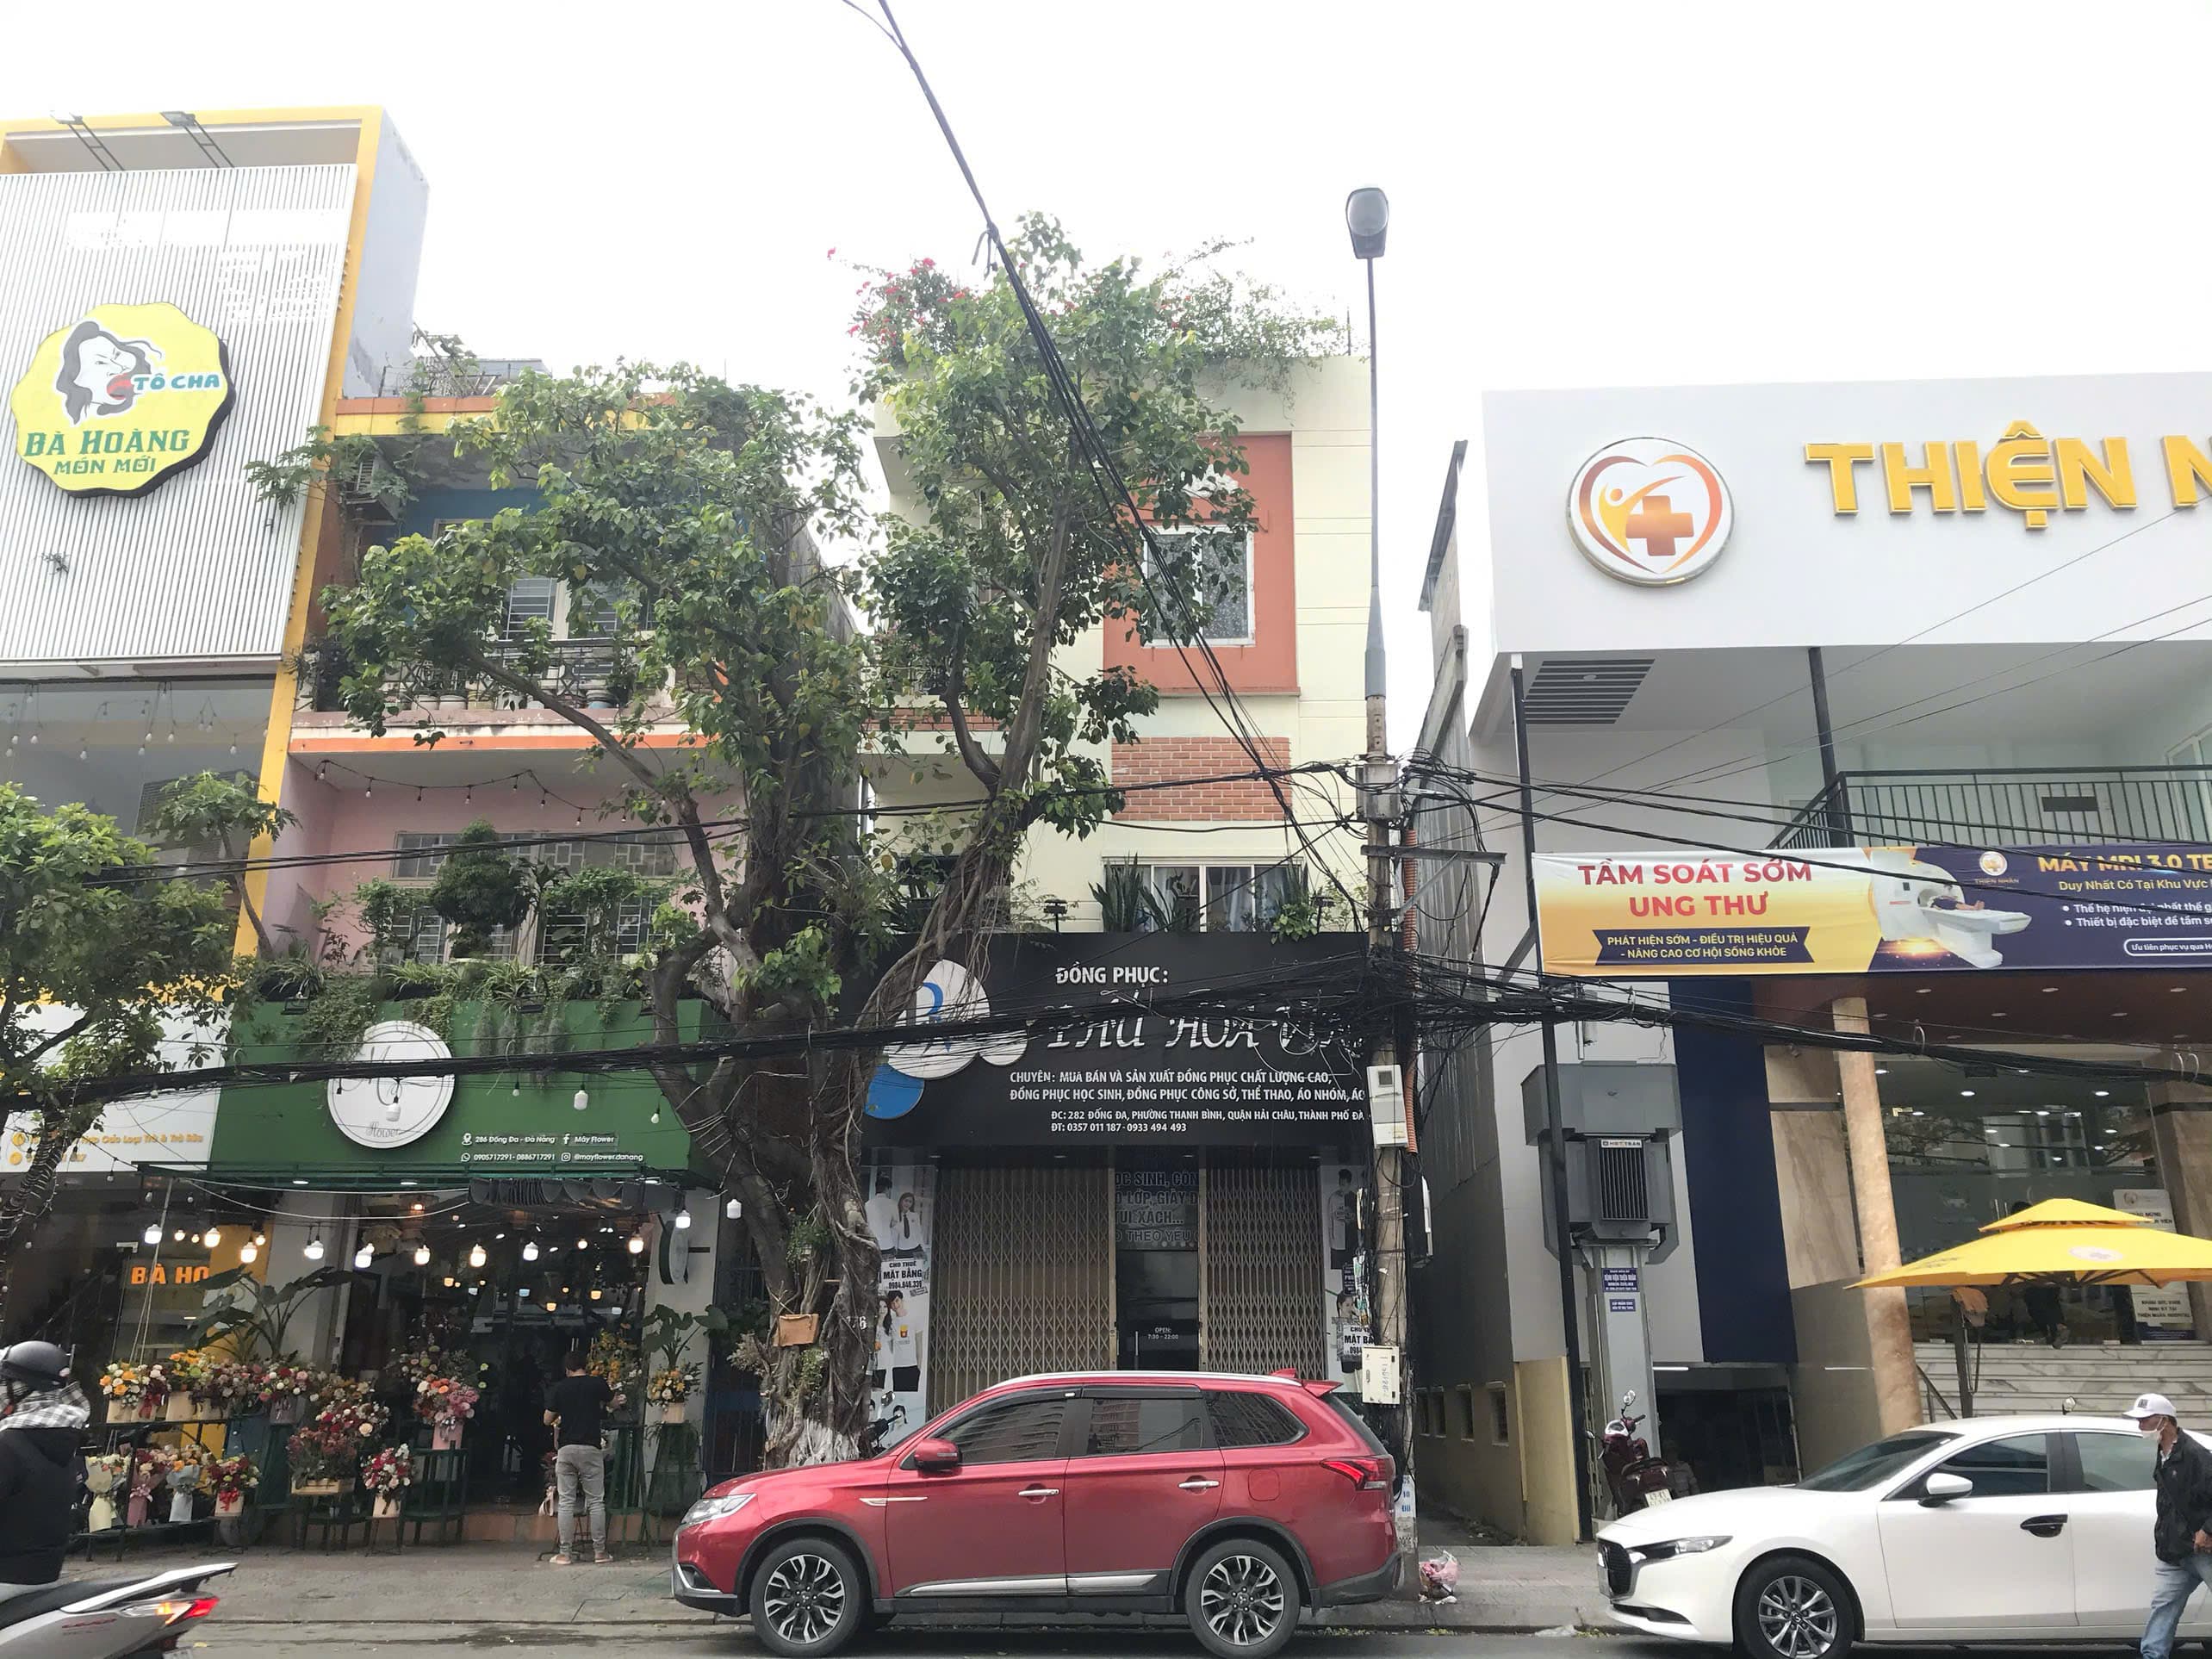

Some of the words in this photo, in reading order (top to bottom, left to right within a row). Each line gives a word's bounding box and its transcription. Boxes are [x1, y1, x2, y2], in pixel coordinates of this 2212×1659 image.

[134, 373, 165, 391] TÔ
[171, 374, 220, 388] CHA
[24, 431, 65, 457] BÀ
[79, 428, 190, 455] HOÀNG
[113, 455, 156, 473] MỚI
[1804, 419, 2139, 531] THIỆN
[1578, 858, 1643, 885] TẦM
[1654, 858, 1733, 884] SOÁT
[1743, 857, 1812, 882] SỚM
[2059, 881, 2082, 892] Duy
[2085, 879, 2115, 890] Nhất
[2117, 879, 2134, 890] Có
[2134, 879, 2154, 892] Tại
[2156, 879, 2181, 889] Khu
[2184, 879, 2209, 892] Vực
[1629, 896, 1695, 917] UNG
[1704, 891, 1768, 916] THƯ
[2076, 916, 2104, 927] Thiết
[2106, 917, 2117, 929] bị
[2119, 916, 2140, 928] đặc
[2141, 916, 2162, 928] biệt
[1607, 935, 1636, 946] PHÁT
[1637, 934, 1663, 947] HIỆN
[1666, 934, 1690, 945] SỚM
[1699, 933, 1724, 944] ĐIỀU
[1727, 935, 1744, 945] TRỊ
[1747, 933, 1772, 944] HIỆU
[1775, 932, 1798, 944] QUẢ
[1627, 948, 1658, 959] NÂNG
[1660, 949, 1682, 958] CAO
[1685, 948, 1700, 958] CƠ
[1702, 948, 1722, 960] HỘI
[1724, 947, 1755, 957] SỐNG
[1756, 946, 1786, 957] KHỎE
[1055, 961, 1107, 985] ĐỒNG
[1010, 1070, 1055, 1083] CHUYÊN:
[1085, 1069, 1108, 1083] BÁN
[1109, 1069, 1123, 1083] VÀ
[1126, 1068, 1146, 1083] SẢN
[1149, 1068, 1175, 1083] XUẤT
[1177, 1068, 1207, 1083] ĐỒNG
[1209, 1072, 1238, 1085] PHỤC
[1240, 1068, 1267, 1083] CHẤT
[1269, 1071, 1305, 1085] LƯỢNG
[1307, 1072, 1333, 1084] CAO,
[1010, 1085, 1040, 1100] ĐỒNG
[1042, 1089, 1071, 1103] PHỤC
[1072, 1089, 1096, 1103] HỌC
[1097, 1089, 1126, 1102] SINH,
[1127, 1085, 1157, 1100] ĐỒNG
[1159, 1089, 1188, 1103] PHỤC
[1190, 1087, 1221, 1100] CÔNG
[1222, 1085, 1240, 1102] SỞ,
[1241, 1085, 1262, 1100] THỂ
[1263, 1089, 1295, 1102] THAO,
[1296, 1086, 1312, 1100] ÁO
[1314, 1085, 1351, 1102] NHÓM,
[1051, 1111, 1066, 1120] ĐC:
[1068, 1111, 1085, 1120] 282
[1087, 1108, 1113, 1120] ĐỐNG
[1115, 1110, 1130, 1122] ĐA,
[1131, 1109, 1167, 1120] PHƯỜNG
[1170, 1110, 1198, 1120] THANH
[1202, 1109, 1226, 1121] BÌNH,
[1227, 1109, 1252, 1122] QUẬN
[1254, 1109, 1270, 1120] HẢI
[1271, 1109, 1297, 1121] CHÂU,
[1298, 1109, 1329, 1120] THÀNH
[1331, 1109, 1350, 1120] PHỐ
[1051, 1123, 1066, 1132] ĐT:
[1066, 1123, 1088, 1132] 0357
[1090, 1123, 1104, 1132] 011
[1106, 1123, 1121, 1132] 187
[1127, 1123, 1148, 1132] 0933
[1150, 1123, 1167, 1132] 494
[1170, 1123, 1187, 1132] 493
[131, 1264, 166, 1284] BÀ
